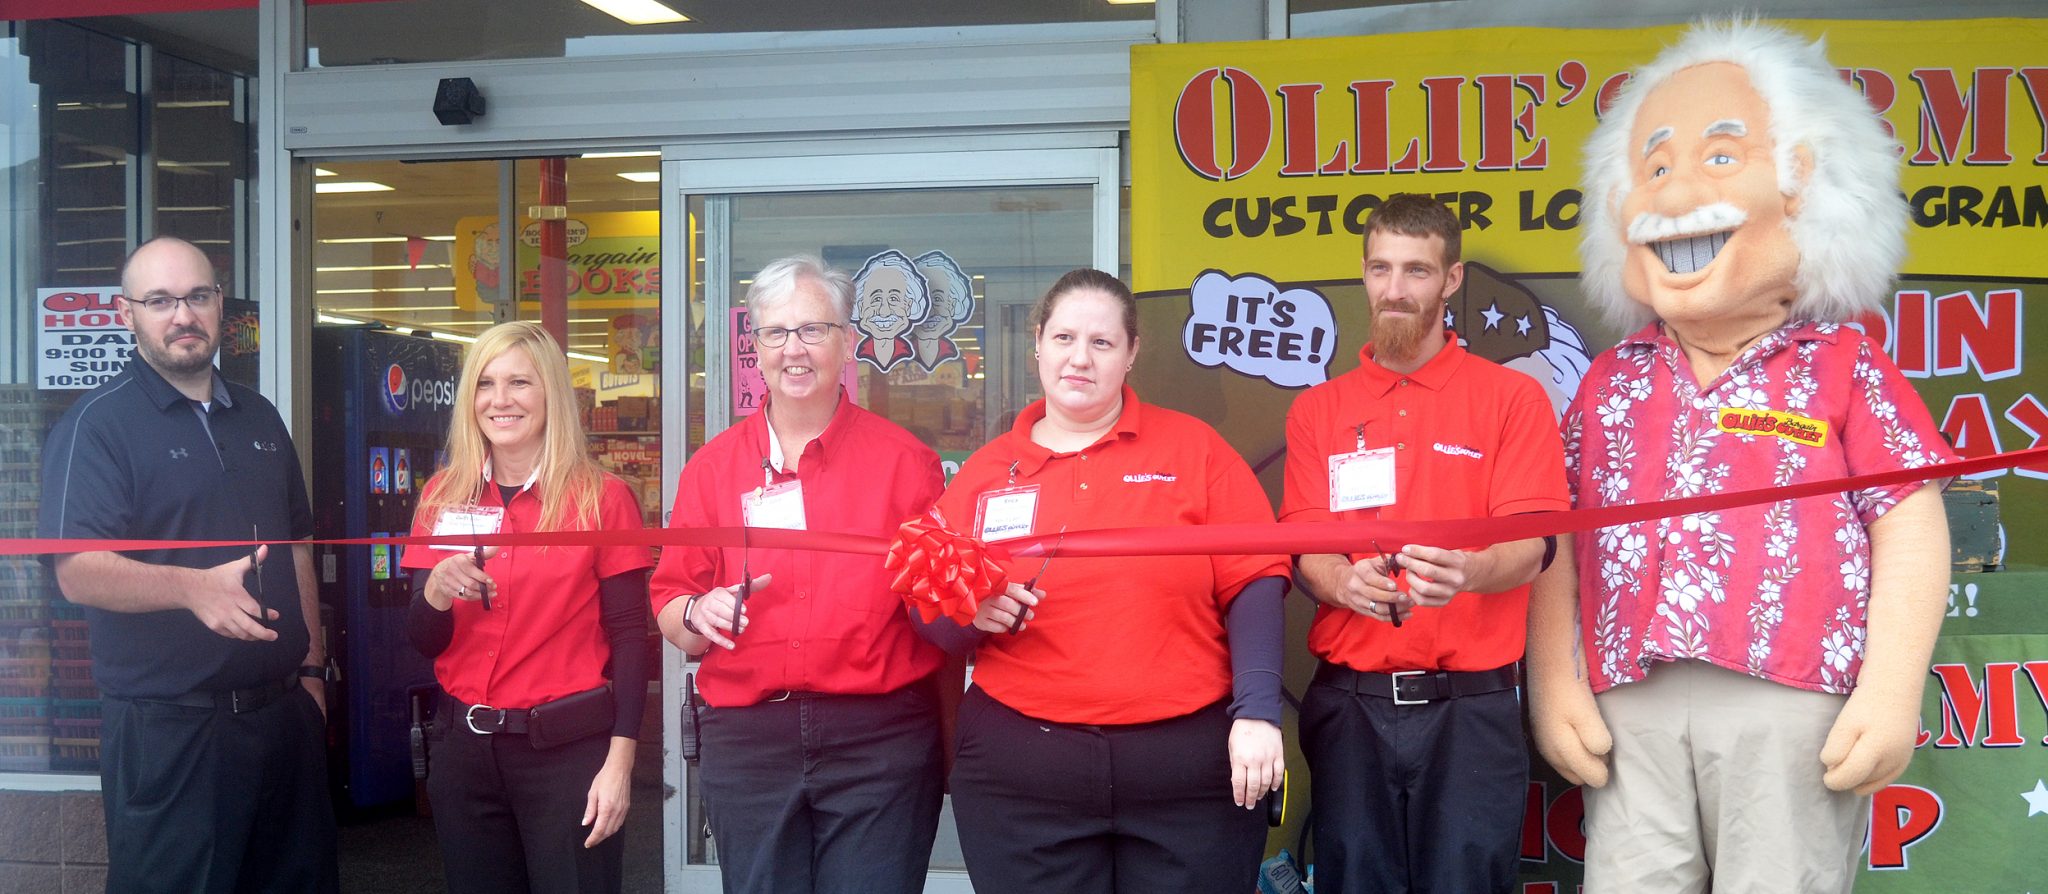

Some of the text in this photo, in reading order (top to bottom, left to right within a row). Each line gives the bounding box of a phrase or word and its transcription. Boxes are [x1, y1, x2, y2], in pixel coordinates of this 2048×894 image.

[1899, 184, 2048, 230] GRAM
[566, 246, 658, 273] argain
[1226, 292, 1296, 328] IT'S
[45, 348, 107, 359] 9:00
[1191, 323, 1326, 364] FREE!
[70, 361, 131, 372] SUN
[411, 375, 455, 411] pepsi
[1722, 412, 1778, 432] OLLIE'S
